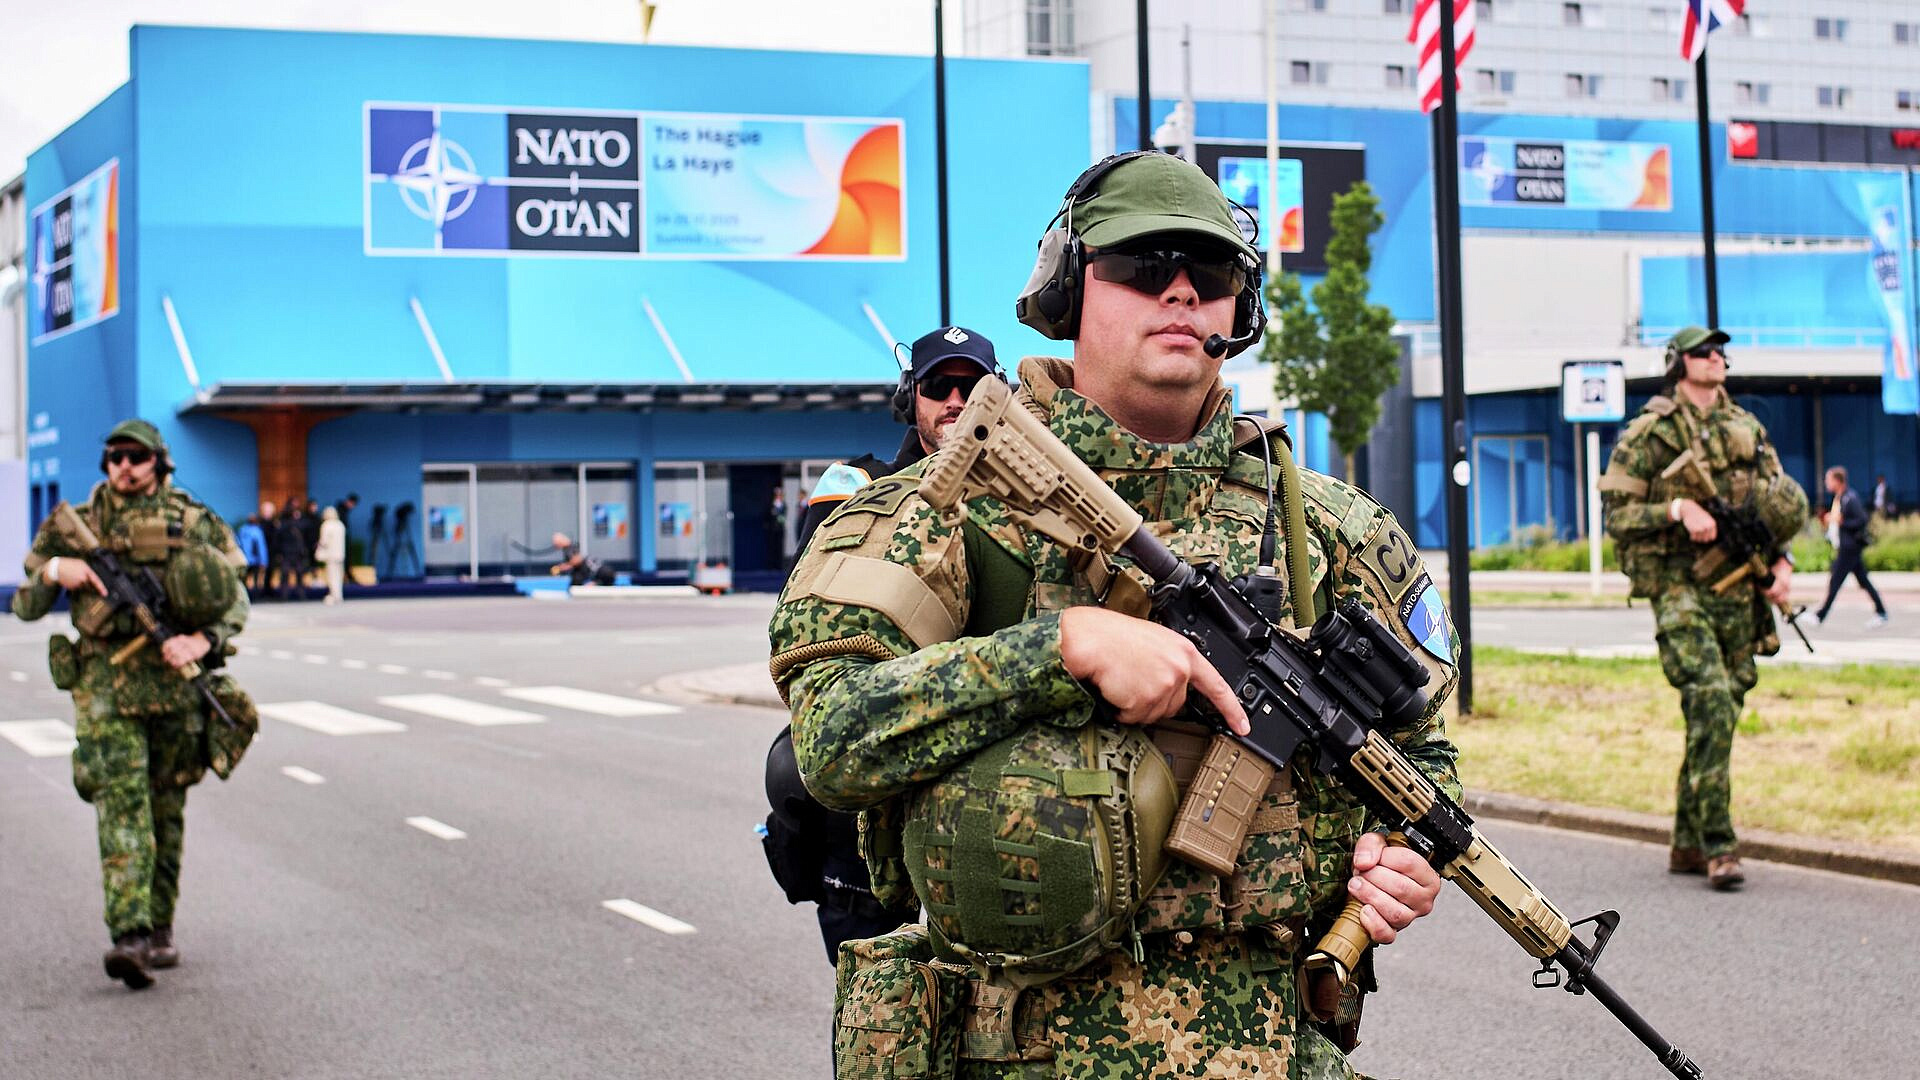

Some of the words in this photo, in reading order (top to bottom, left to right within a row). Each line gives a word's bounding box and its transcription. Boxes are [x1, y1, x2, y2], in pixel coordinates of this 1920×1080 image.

[515, 127, 631, 168] NATO
[696, 127, 761, 149] Hague
[515, 199, 632, 238] OTAN
[1376, 529, 1417, 583] C2
